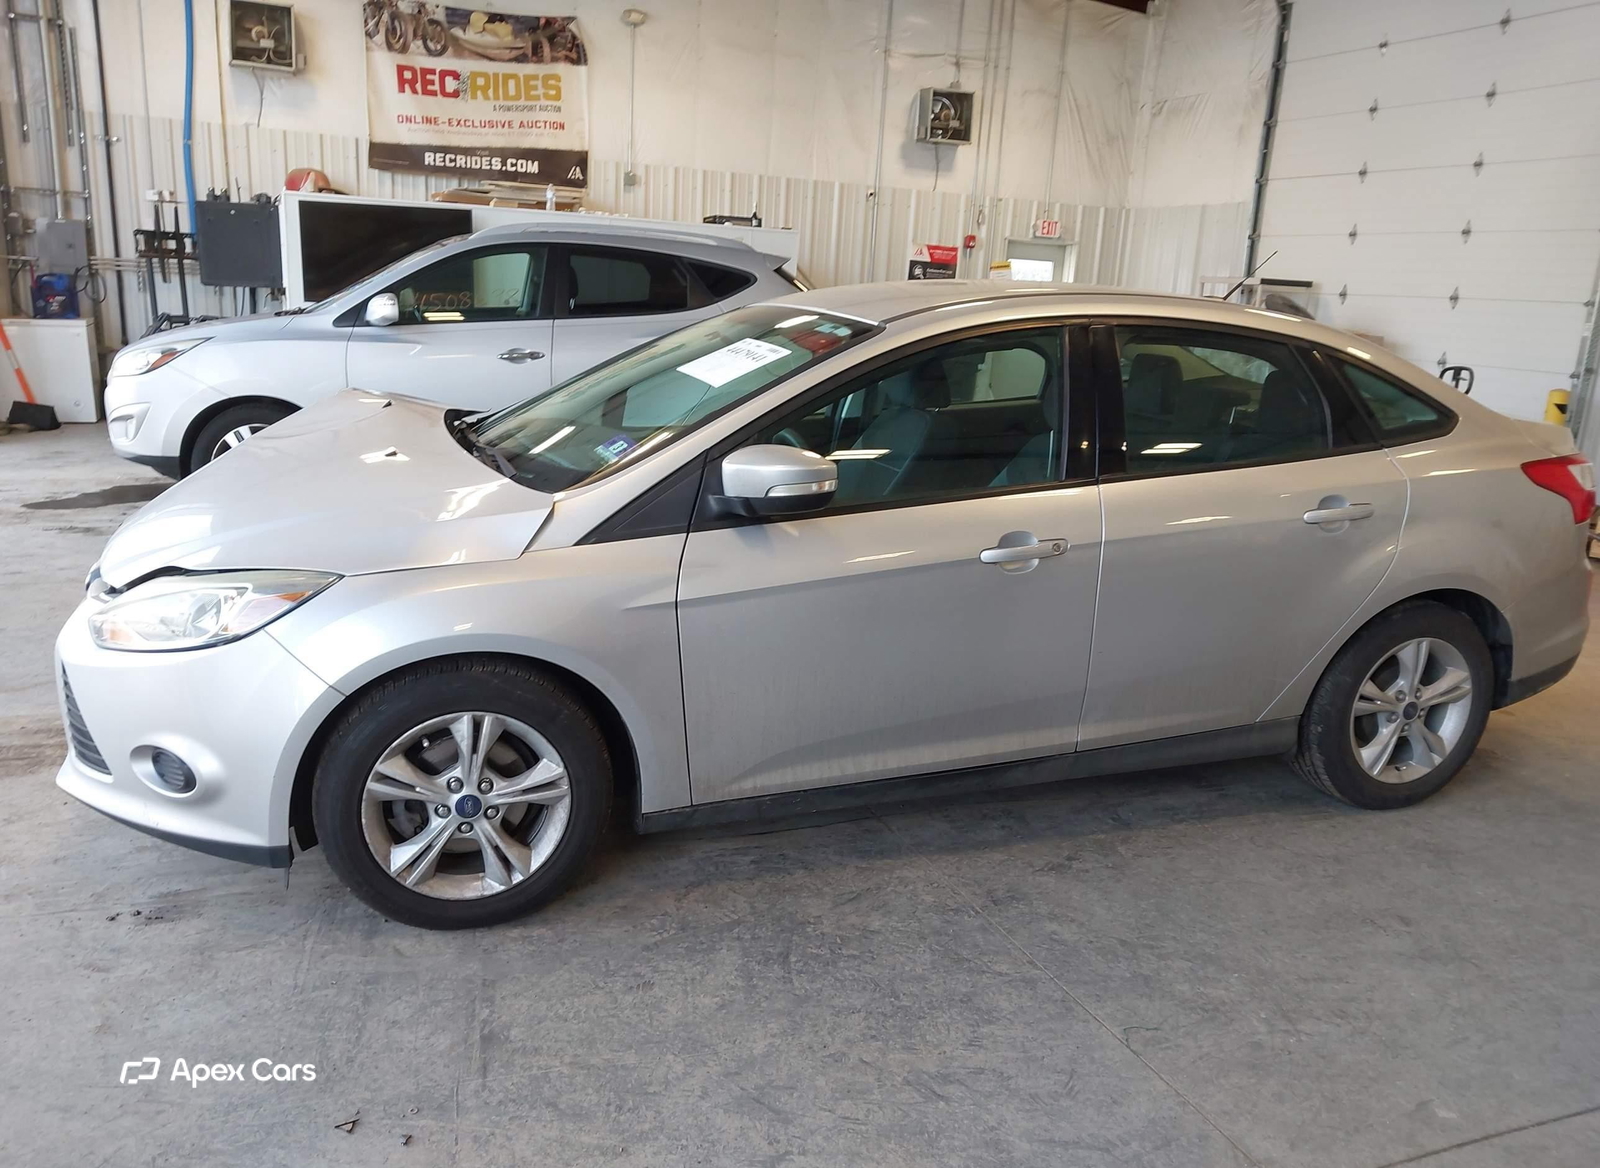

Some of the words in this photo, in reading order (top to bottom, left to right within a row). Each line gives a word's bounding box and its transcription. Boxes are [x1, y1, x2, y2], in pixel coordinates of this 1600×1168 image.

[396, 64, 461, 99] REC
[469, 71, 563, 102] RIDES
[539, 104, 562, 113] AUCTION
[397, 114, 514, 130] ONLINE-EXCLUSIVE
[518, 120, 566, 131] AUCTION
[424, 151, 539, 174] RECRIDES.COM
[1041, 220, 1058, 236] EXIT
